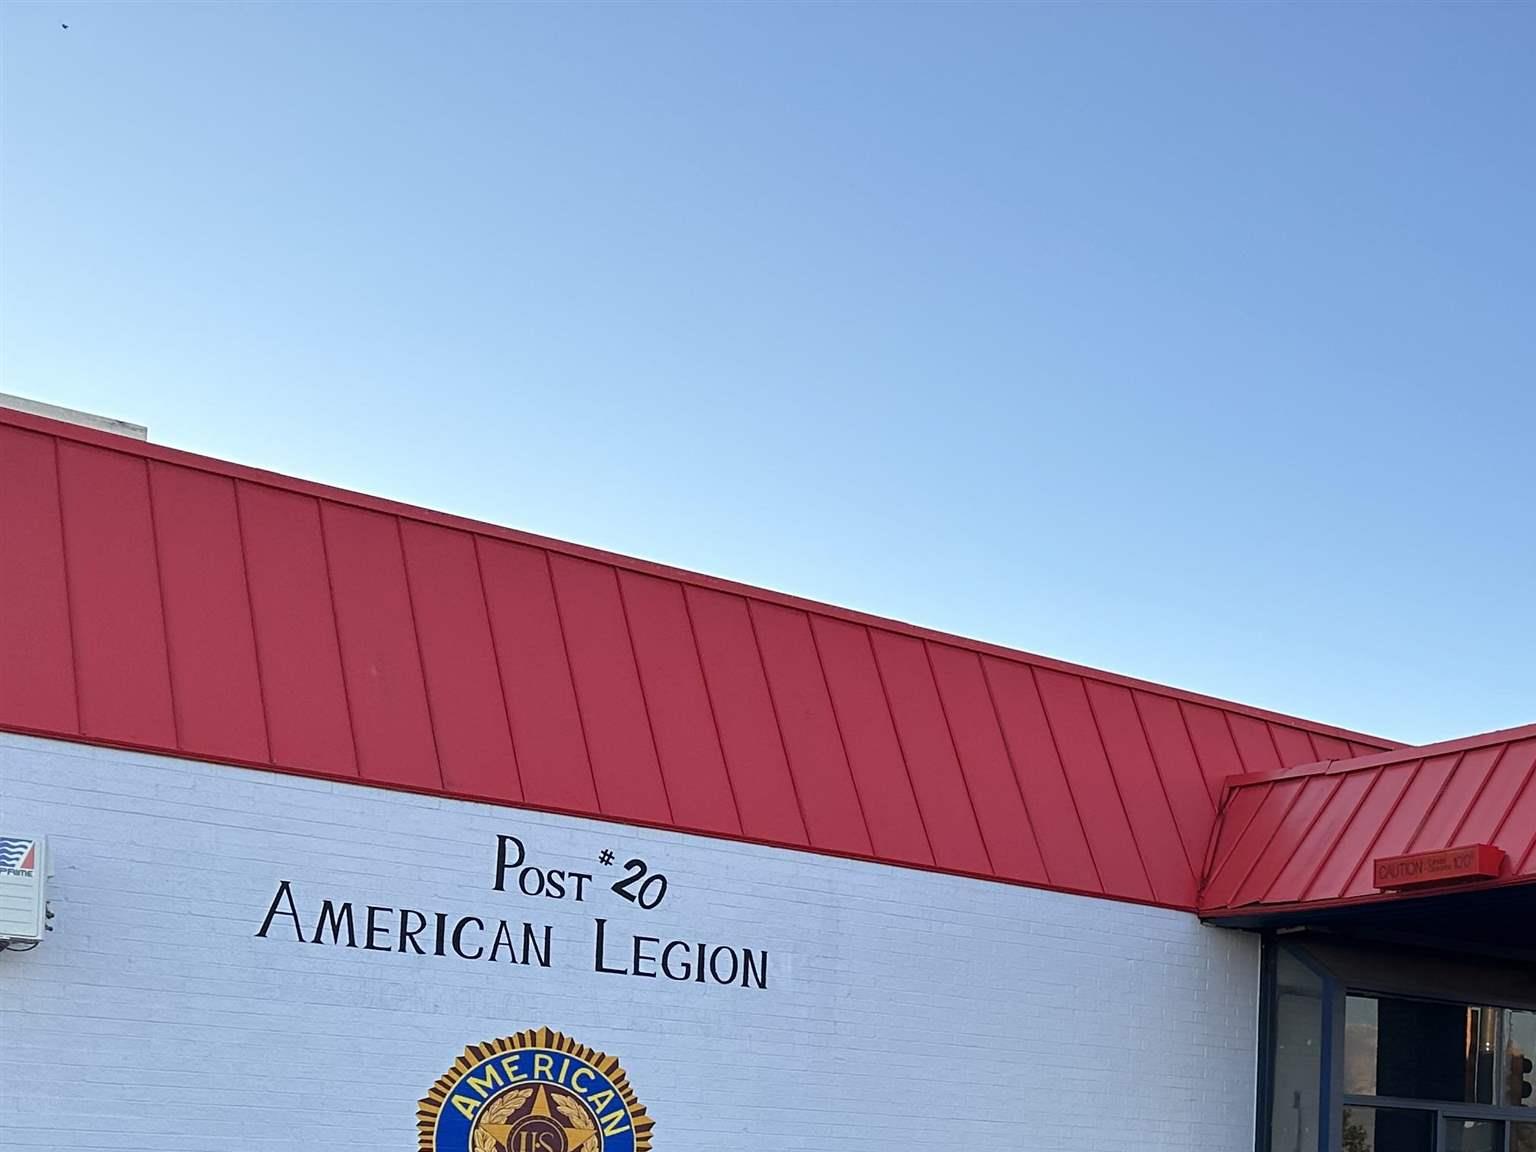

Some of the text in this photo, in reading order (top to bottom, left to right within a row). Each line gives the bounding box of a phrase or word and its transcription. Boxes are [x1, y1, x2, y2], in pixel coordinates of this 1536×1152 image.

[598, 848, 669, 910] #20
[253, 880, 768, 990] AMERICAN LEGION
[451, 1053, 630, 1138] AMERICAN
